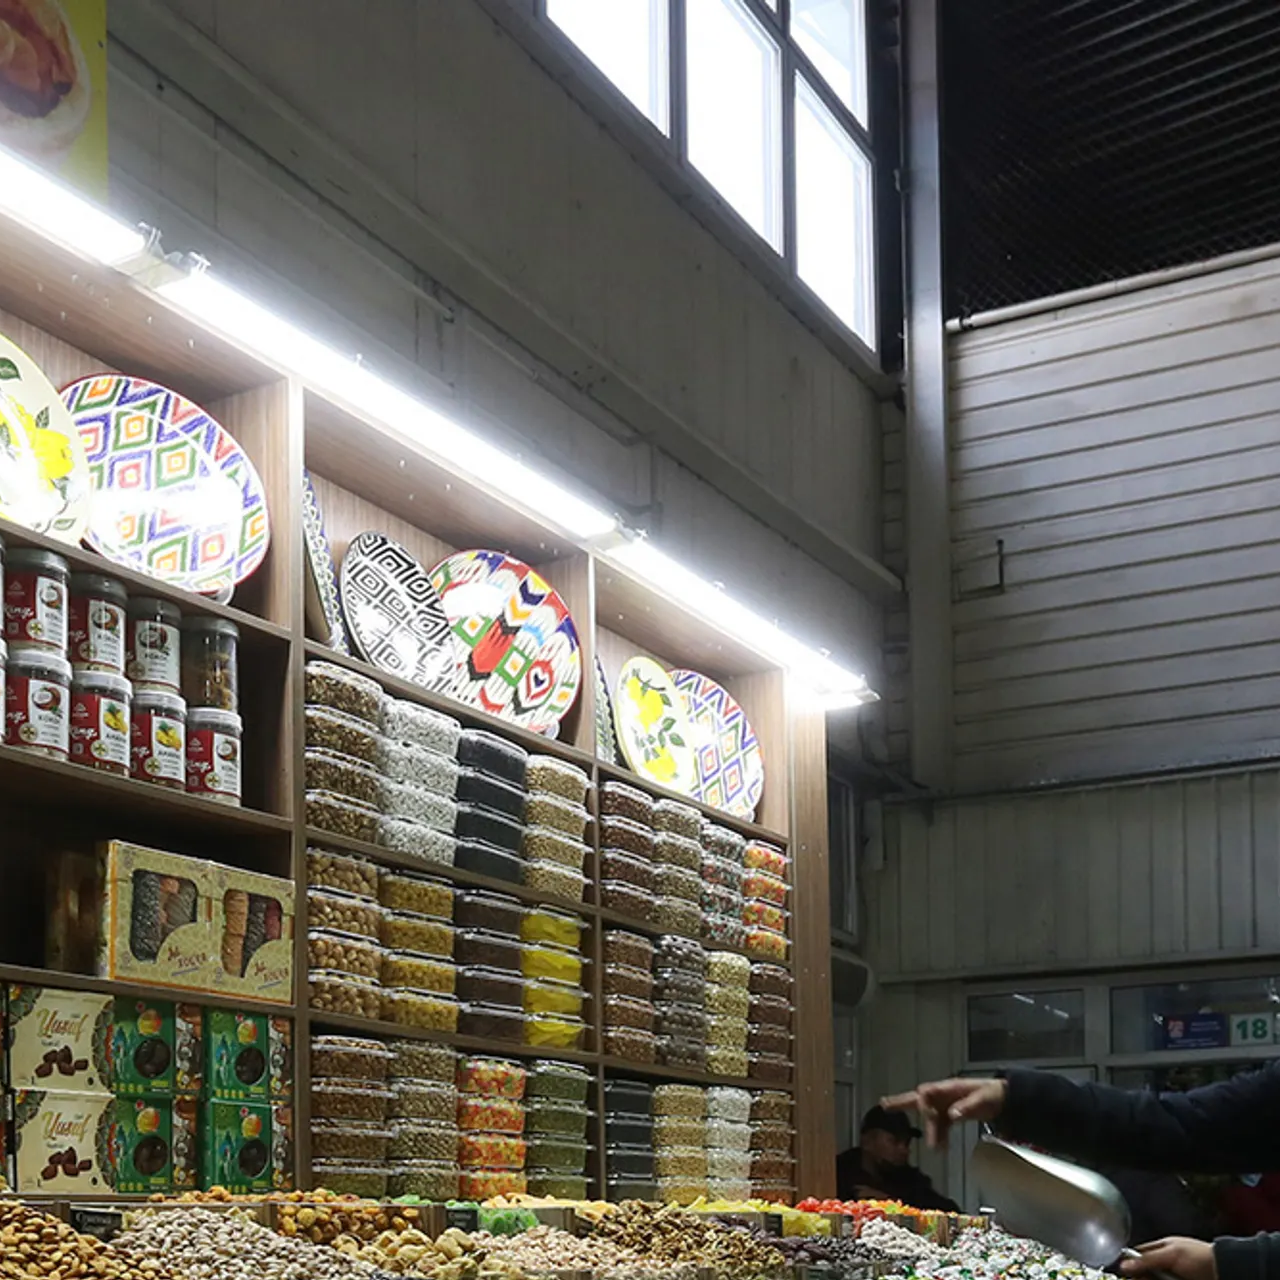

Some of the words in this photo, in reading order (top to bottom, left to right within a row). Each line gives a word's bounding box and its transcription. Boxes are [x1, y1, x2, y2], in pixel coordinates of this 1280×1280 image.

[36, 1008, 88, 1042] Yusuf
[1236, 1018, 1268, 1041] 18
[42, 1110, 88, 1143] Yusuf
